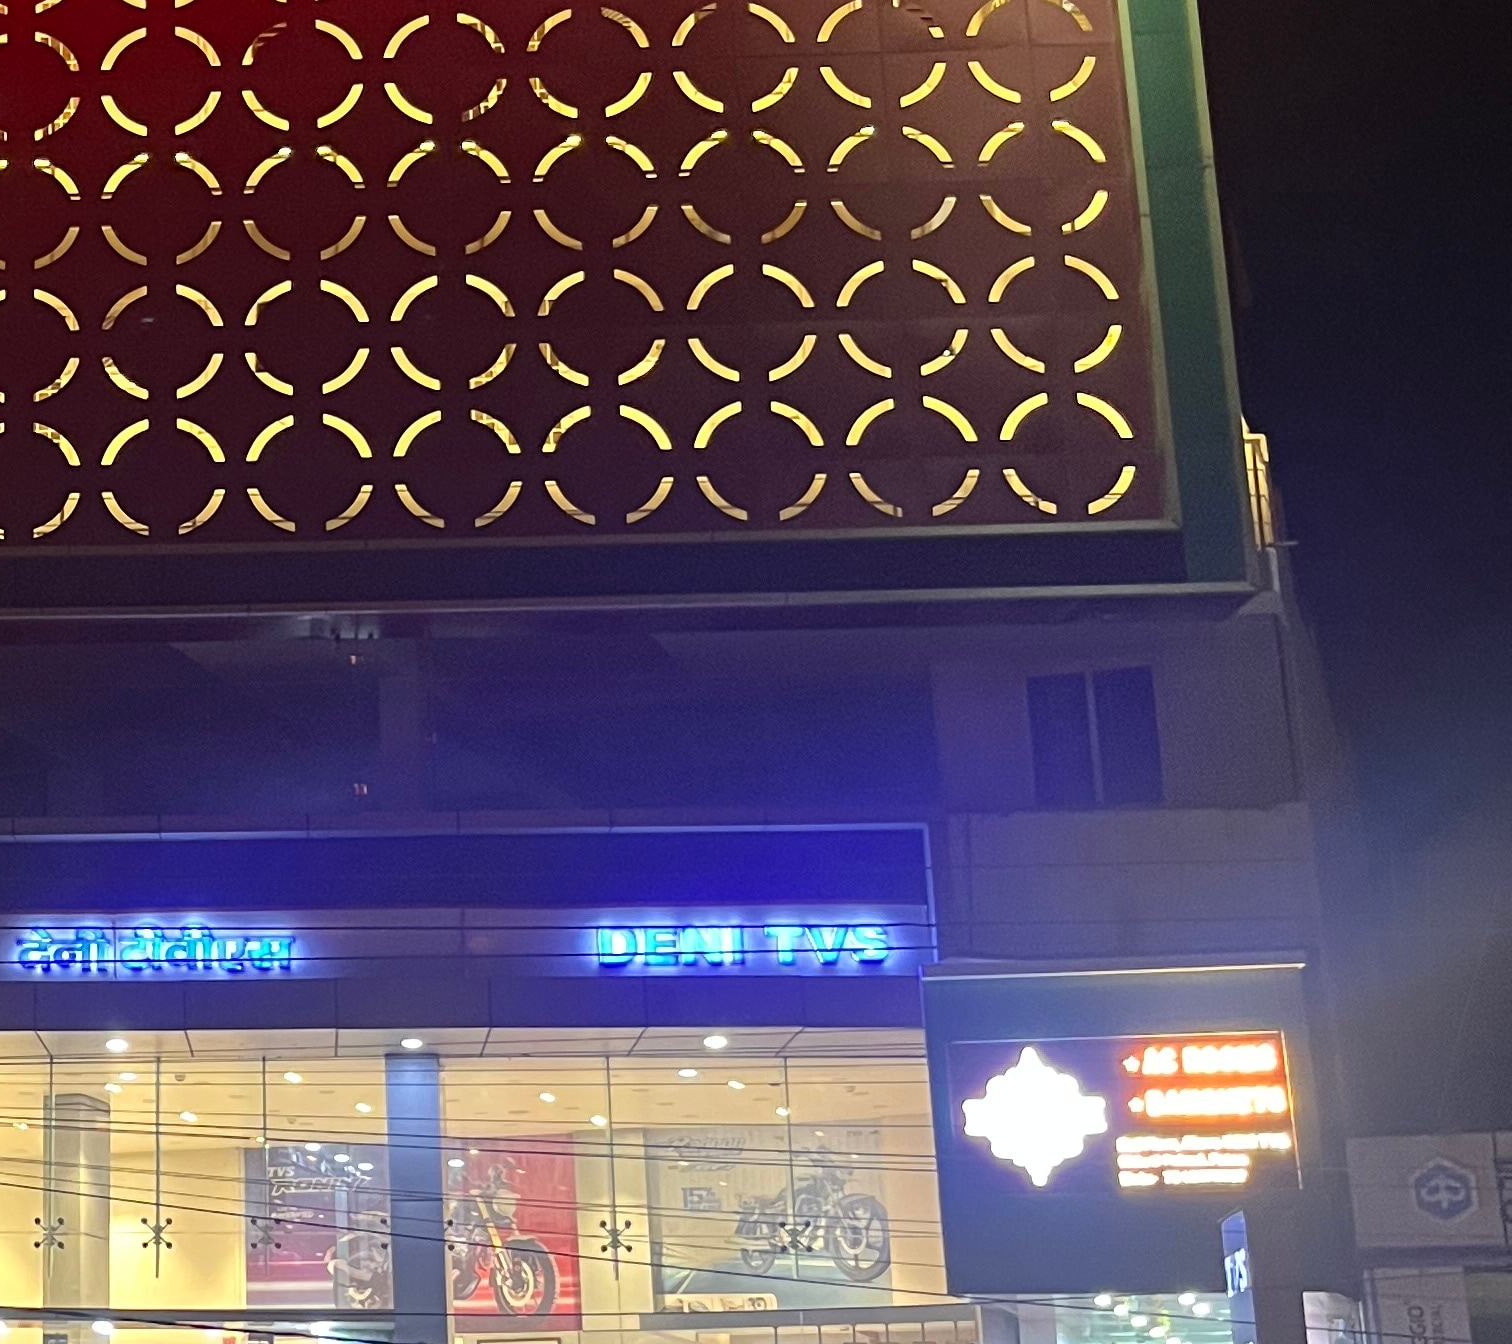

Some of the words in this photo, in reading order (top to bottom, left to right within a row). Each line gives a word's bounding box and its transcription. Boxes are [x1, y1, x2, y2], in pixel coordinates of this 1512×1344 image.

[597, 924, 745, 967] DENI
[764, 923, 889, 966] TVS
[268, 1166, 295, 1178] TVS
